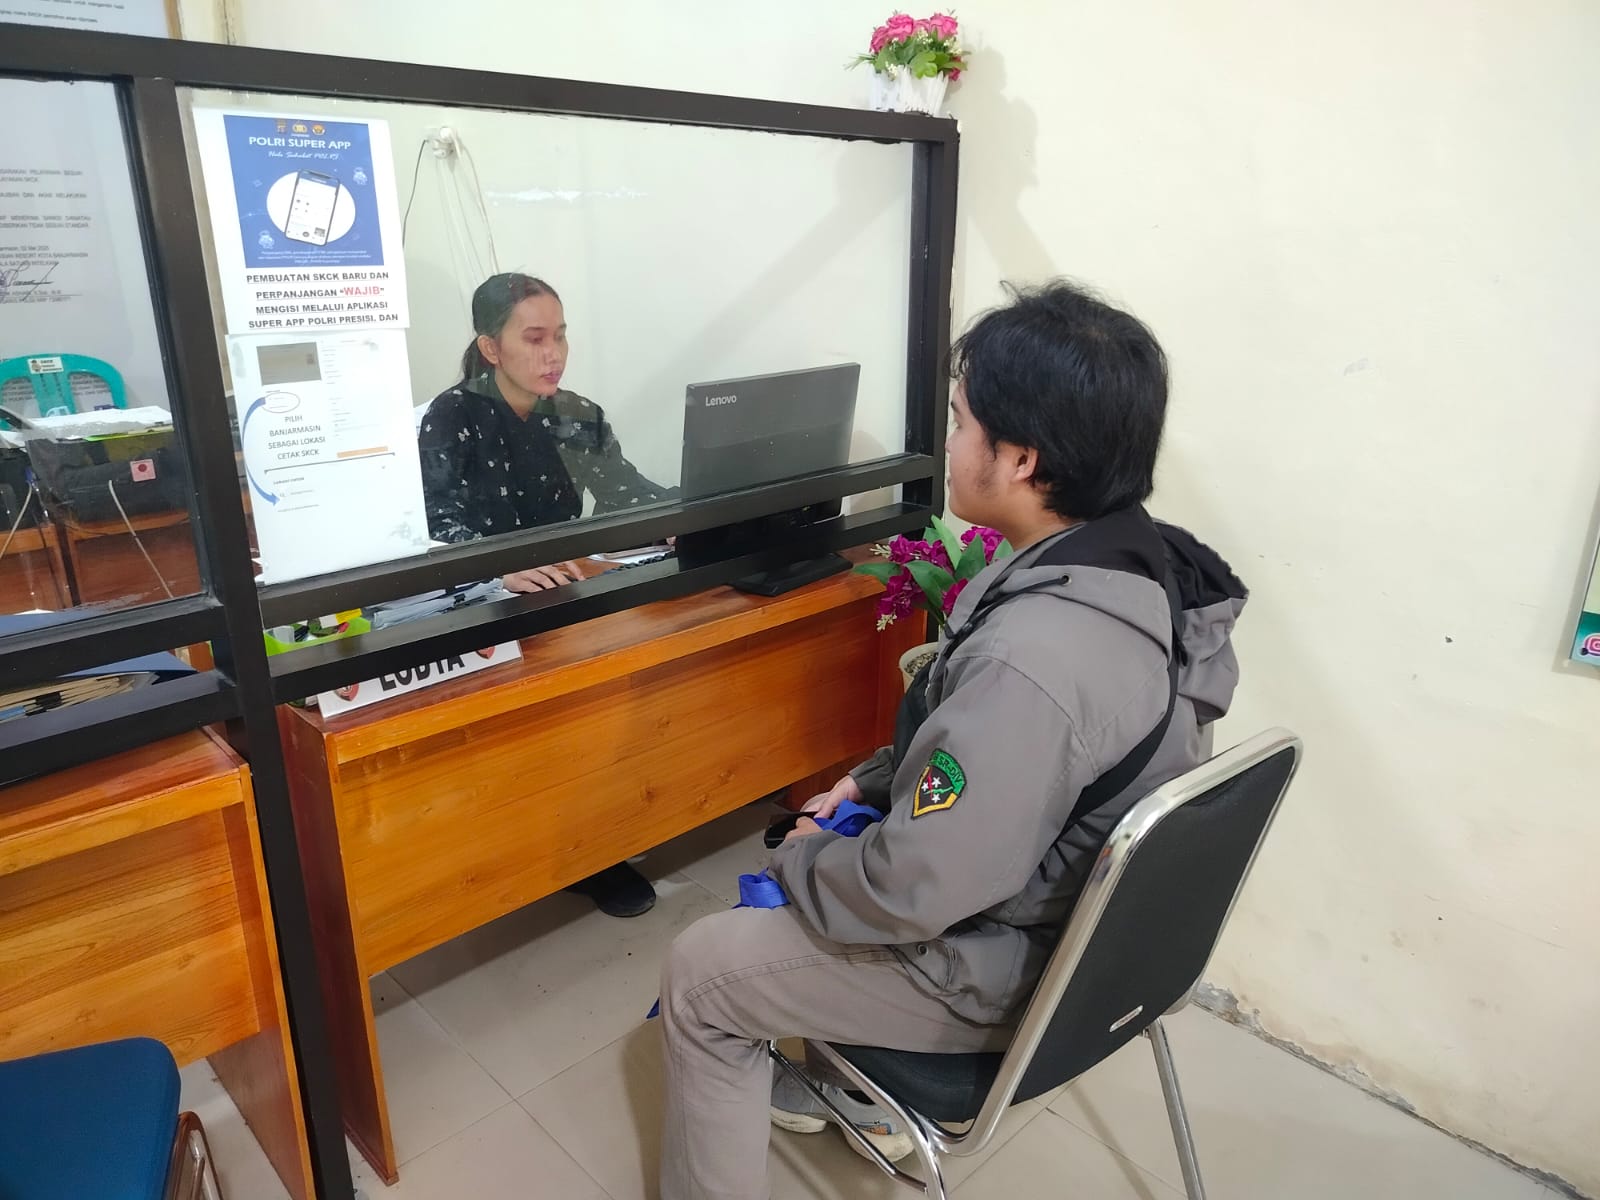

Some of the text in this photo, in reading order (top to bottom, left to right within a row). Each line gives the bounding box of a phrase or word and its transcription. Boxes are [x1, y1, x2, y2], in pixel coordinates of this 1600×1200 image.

[249, 136, 351, 150] POLRI SUPER APP
[246, 271, 389, 283] PEMBUATAN SKCK BARU DAN
[256, 288, 338, 299] PERPANJANGAN
[256, 300, 388, 315] MENGISI MELALUI APLIKASI
[248, 319, 283, 329] SUPER
[285, 318, 305, 328] APP
[308, 316, 337, 326] POLRI
[378, 313, 399, 322] DAN
[705, 395, 737, 407] Lenovo
[284, 415, 303, 423] PILIH
[269, 424, 321, 437] BANJARMASIN
[268, 436, 326, 450] SEBAGAI LOKASI
[277, 448, 321, 460] CETAK SKCK
